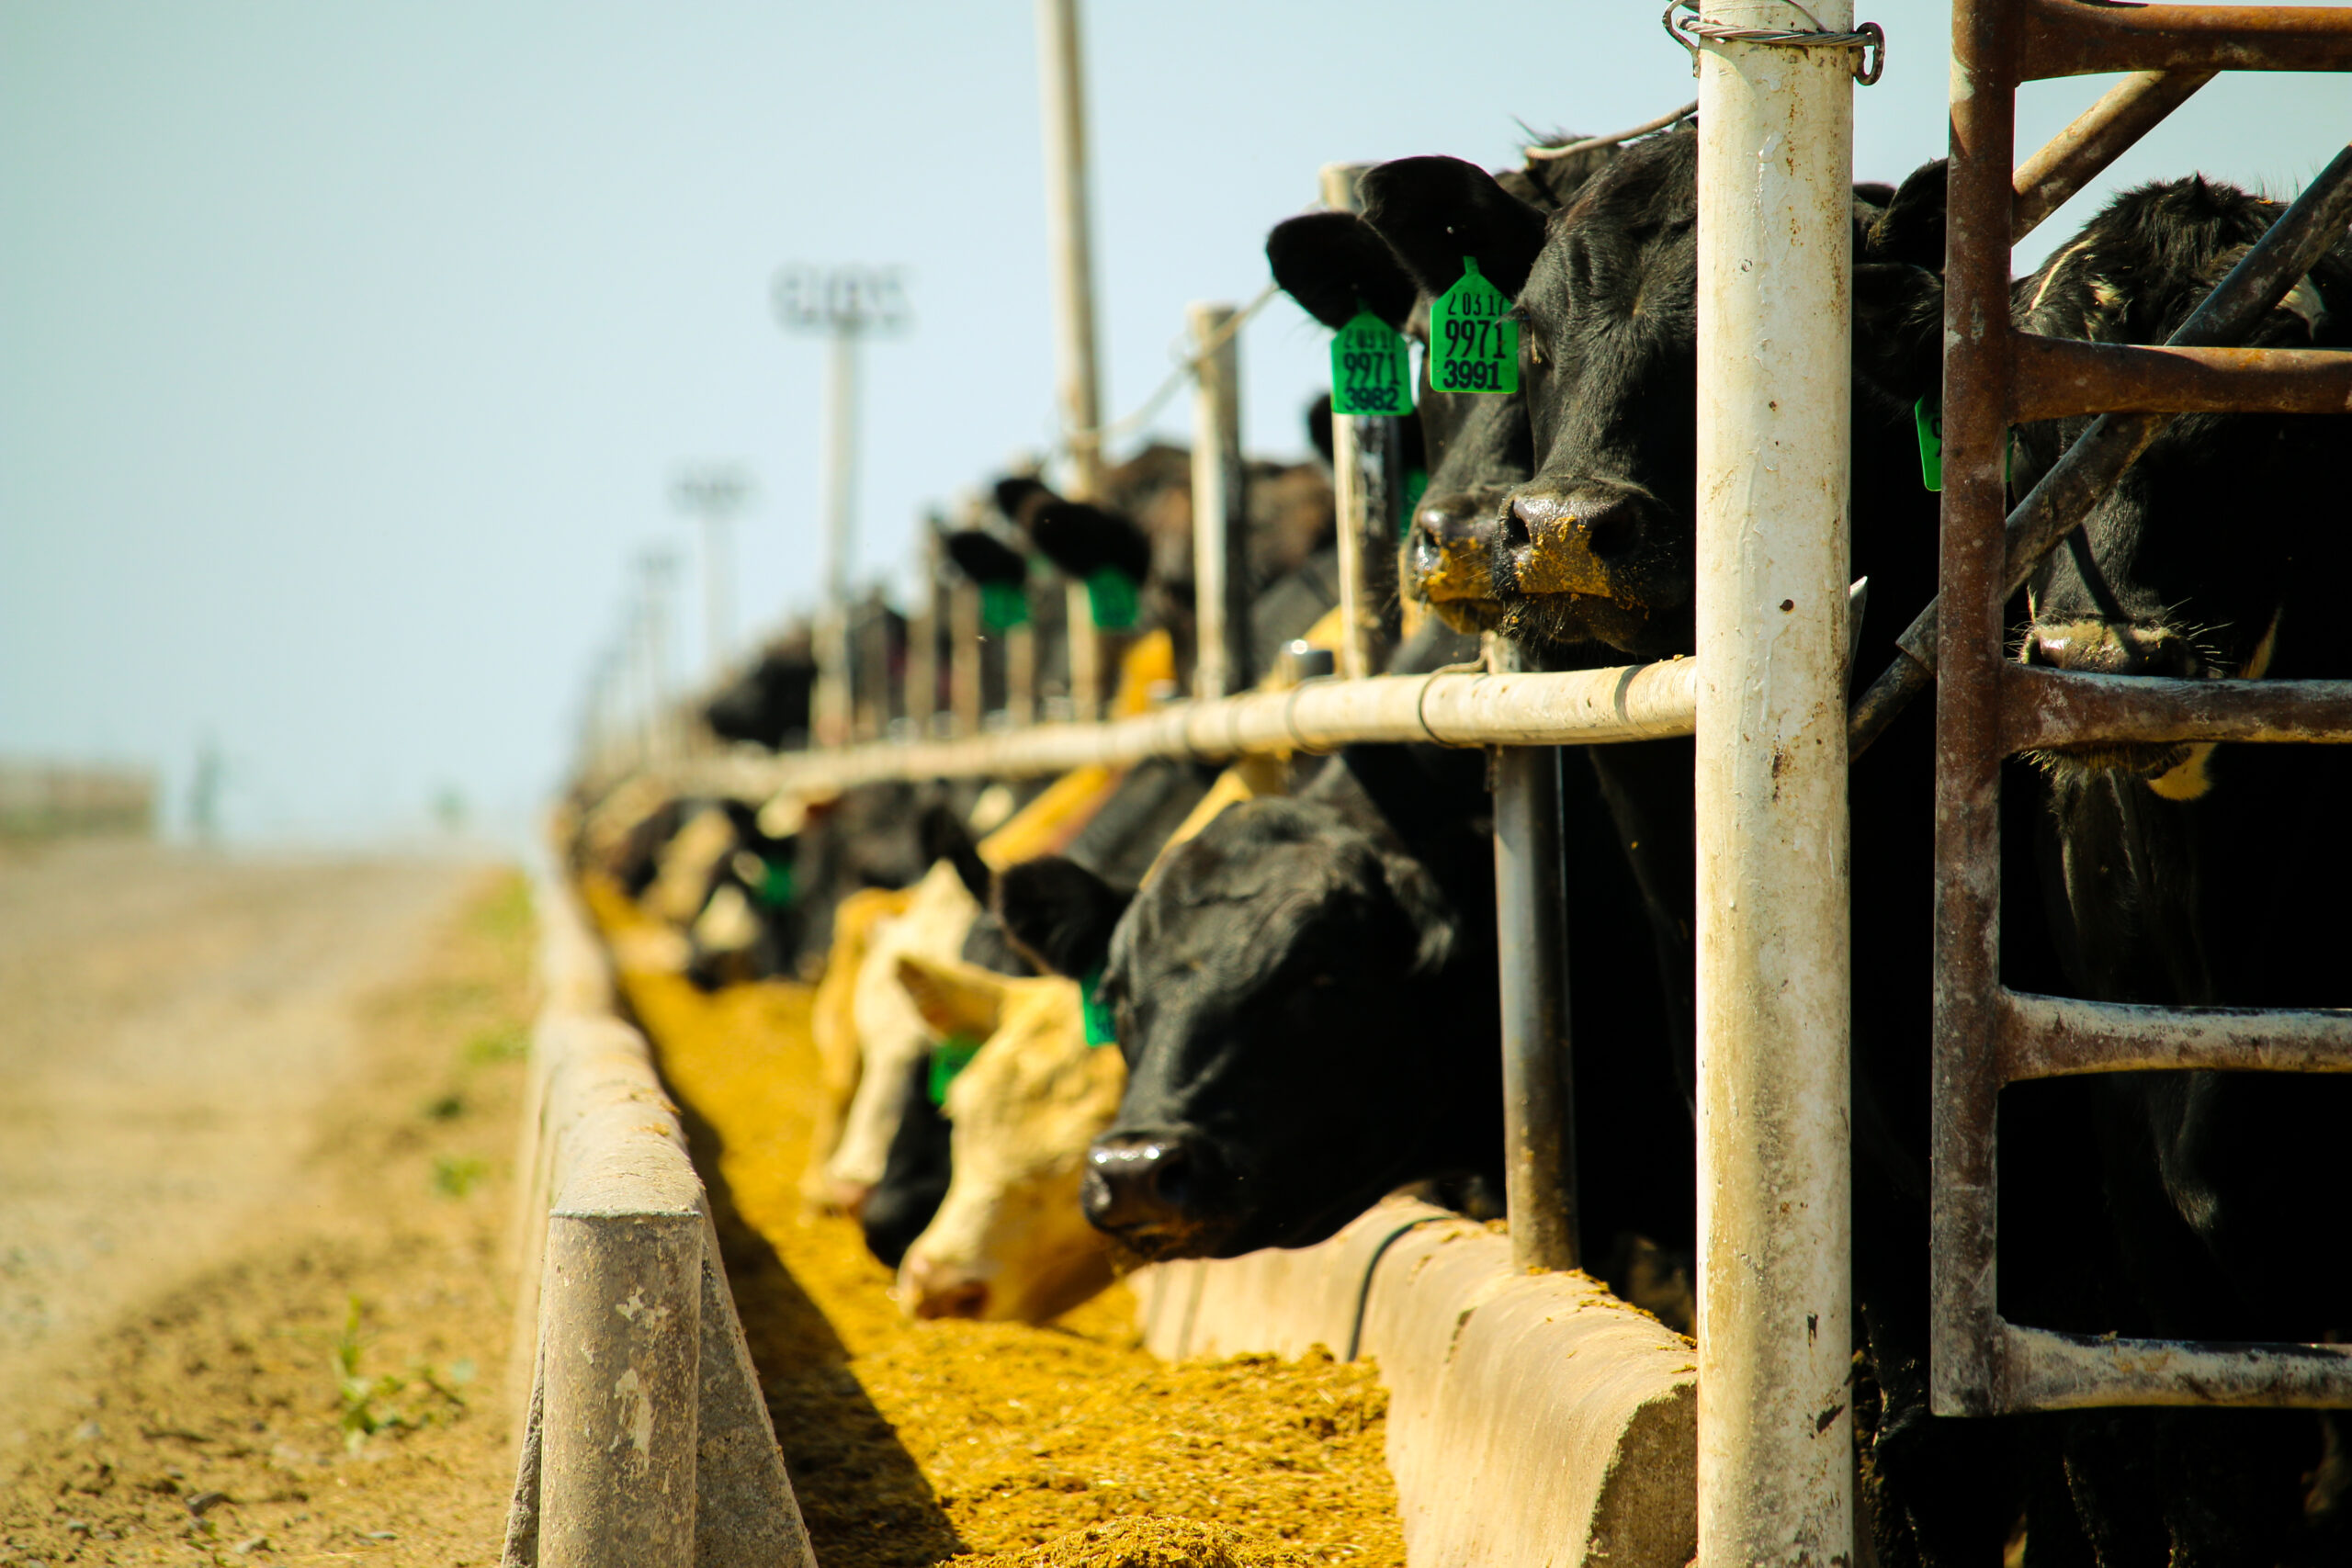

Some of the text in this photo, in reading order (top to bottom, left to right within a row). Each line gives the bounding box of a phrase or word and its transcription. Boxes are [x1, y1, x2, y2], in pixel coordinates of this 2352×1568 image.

[1445, 319, 1507, 359] 9971
[1343, 352, 1402, 387] 9971
[1443, 359, 1503, 390] 3991
[1344, 387, 1400, 412] 3982
